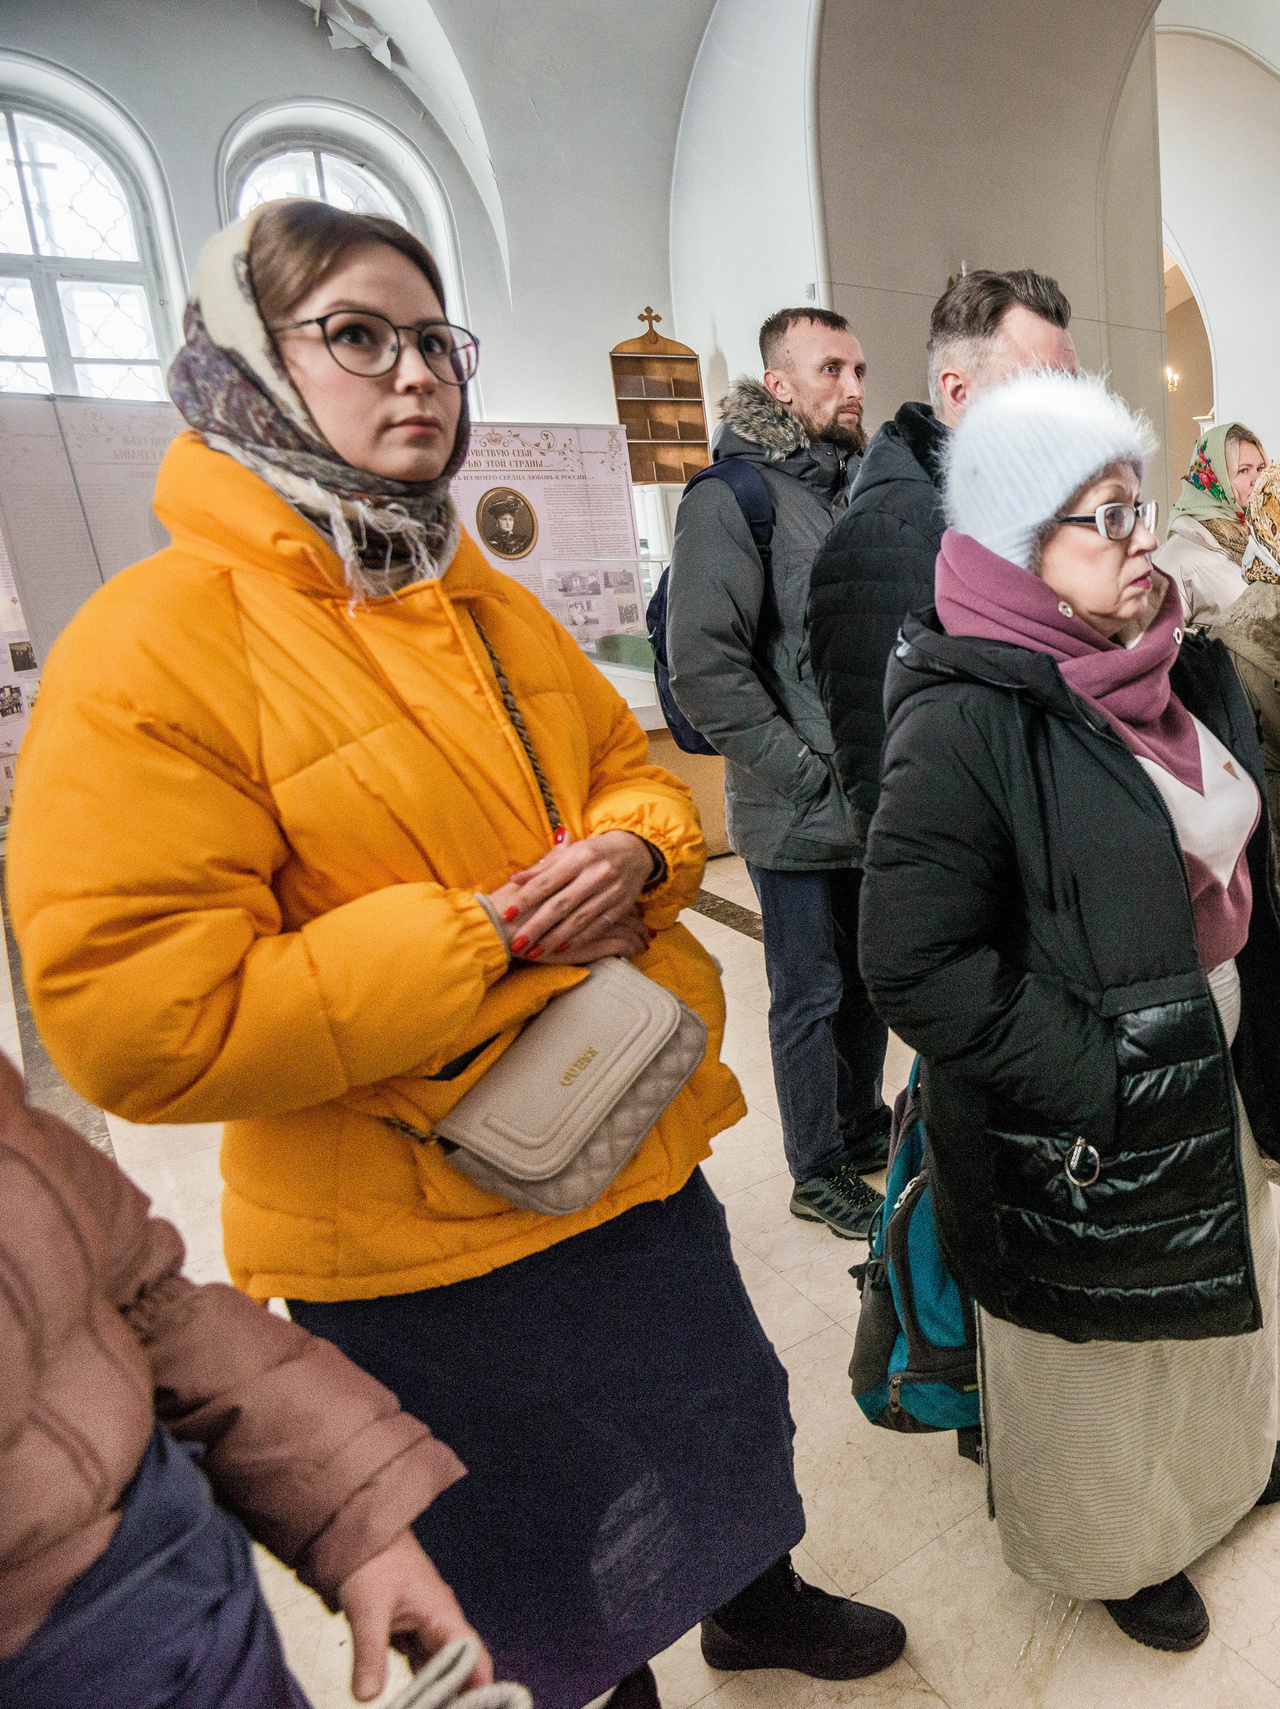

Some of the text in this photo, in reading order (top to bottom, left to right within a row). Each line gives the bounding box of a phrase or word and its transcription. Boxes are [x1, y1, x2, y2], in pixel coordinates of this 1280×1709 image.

[512, 449, 532, 457] СЕБЯ
[485, 459, 507, 468] ЭТОЙ
[499, 474, 526, 482] СЕРДЦА
